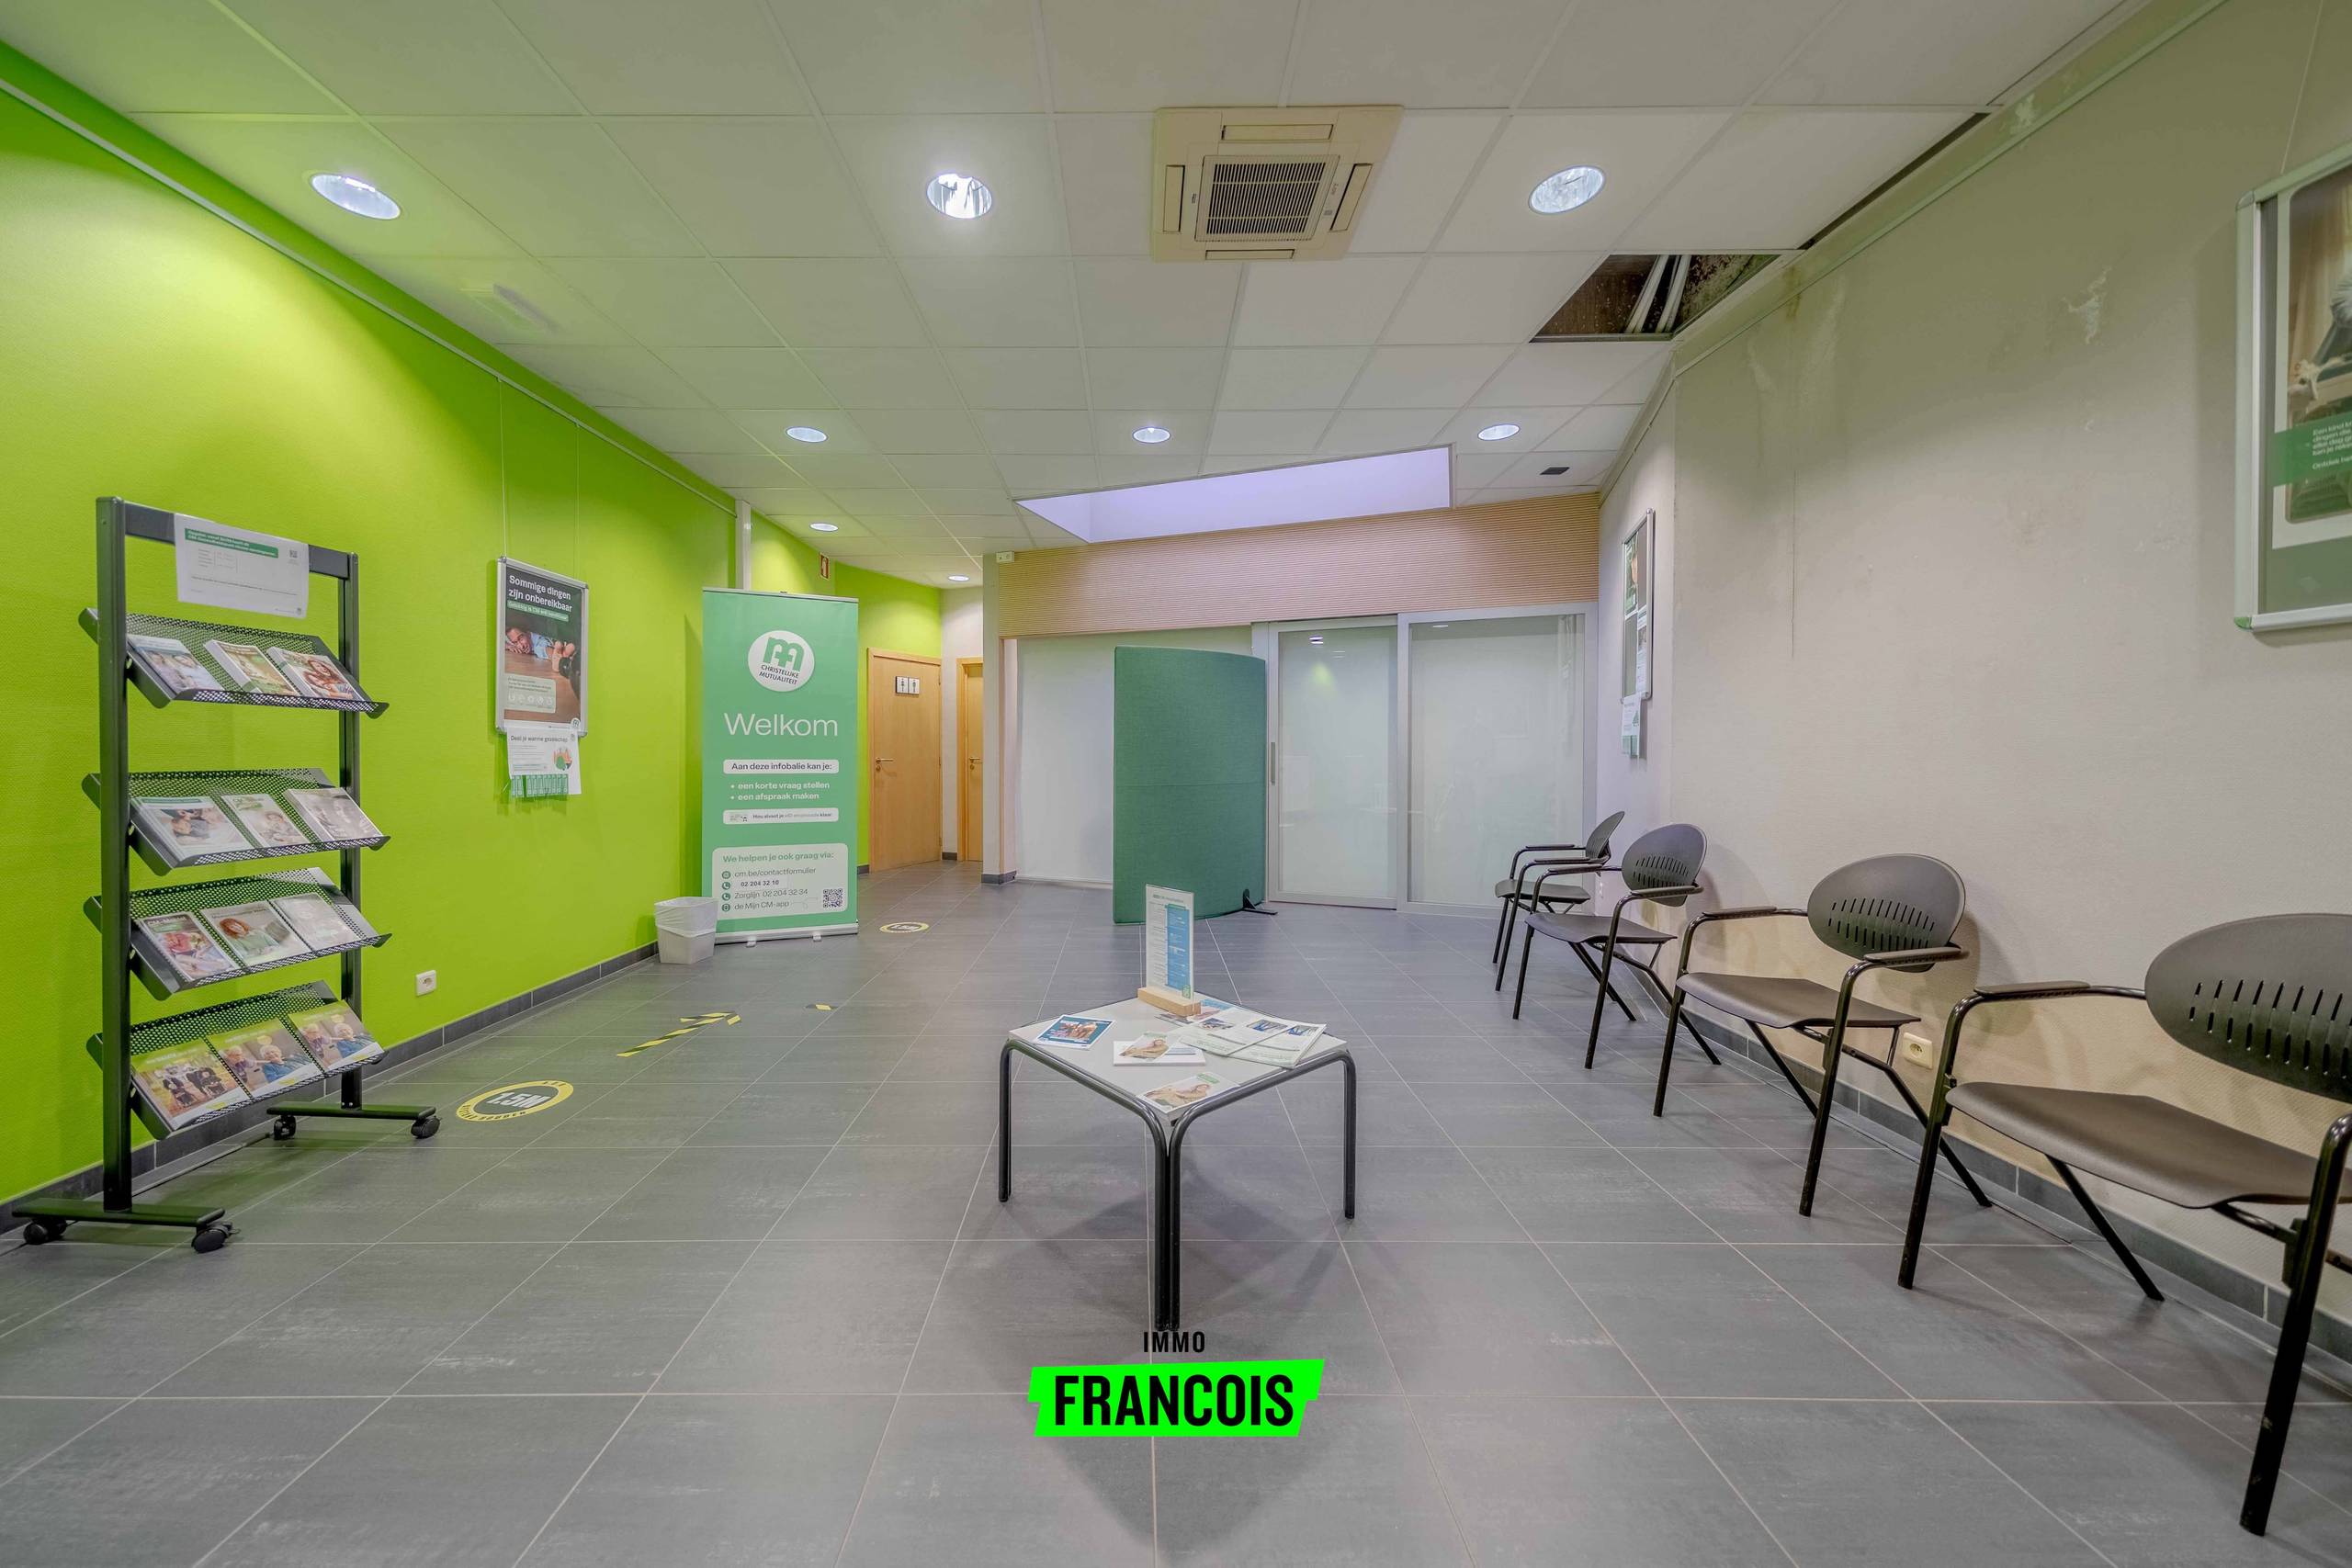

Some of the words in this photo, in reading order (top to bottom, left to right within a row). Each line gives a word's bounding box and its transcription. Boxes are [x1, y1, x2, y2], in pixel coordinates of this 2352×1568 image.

[509, 575, 546, 593] Sommige
[547, 587, 571, 600] dingen
[508, 589, 524, 600] zijn
[525, 593, 572, 612] onbereikbaar
[761, 665, 799, 678] CHRISTELIJKE
[759, 671, 797, 684] MUTUALITEIT
[724, 713, 838, 736] Welkom
[822, 762, 832, 771] je:
[803, 781, 830, 789] stellen
[755, 793, 791, 801] afspraak
[738, 854, 768, 863] helpen
[768, 853, 776, 862] je
[778, 852, 794, 861] ook
[795, 852, 819, 861] graag
[820, 851, 834, 859] via:
[734, 867, 816, 877] cm.be/contactformulier
[735, 891, 760, 899] Zorglijn
[744, 901, 760, 909] Mijn
[761, 900, 790, 908] CM-app
